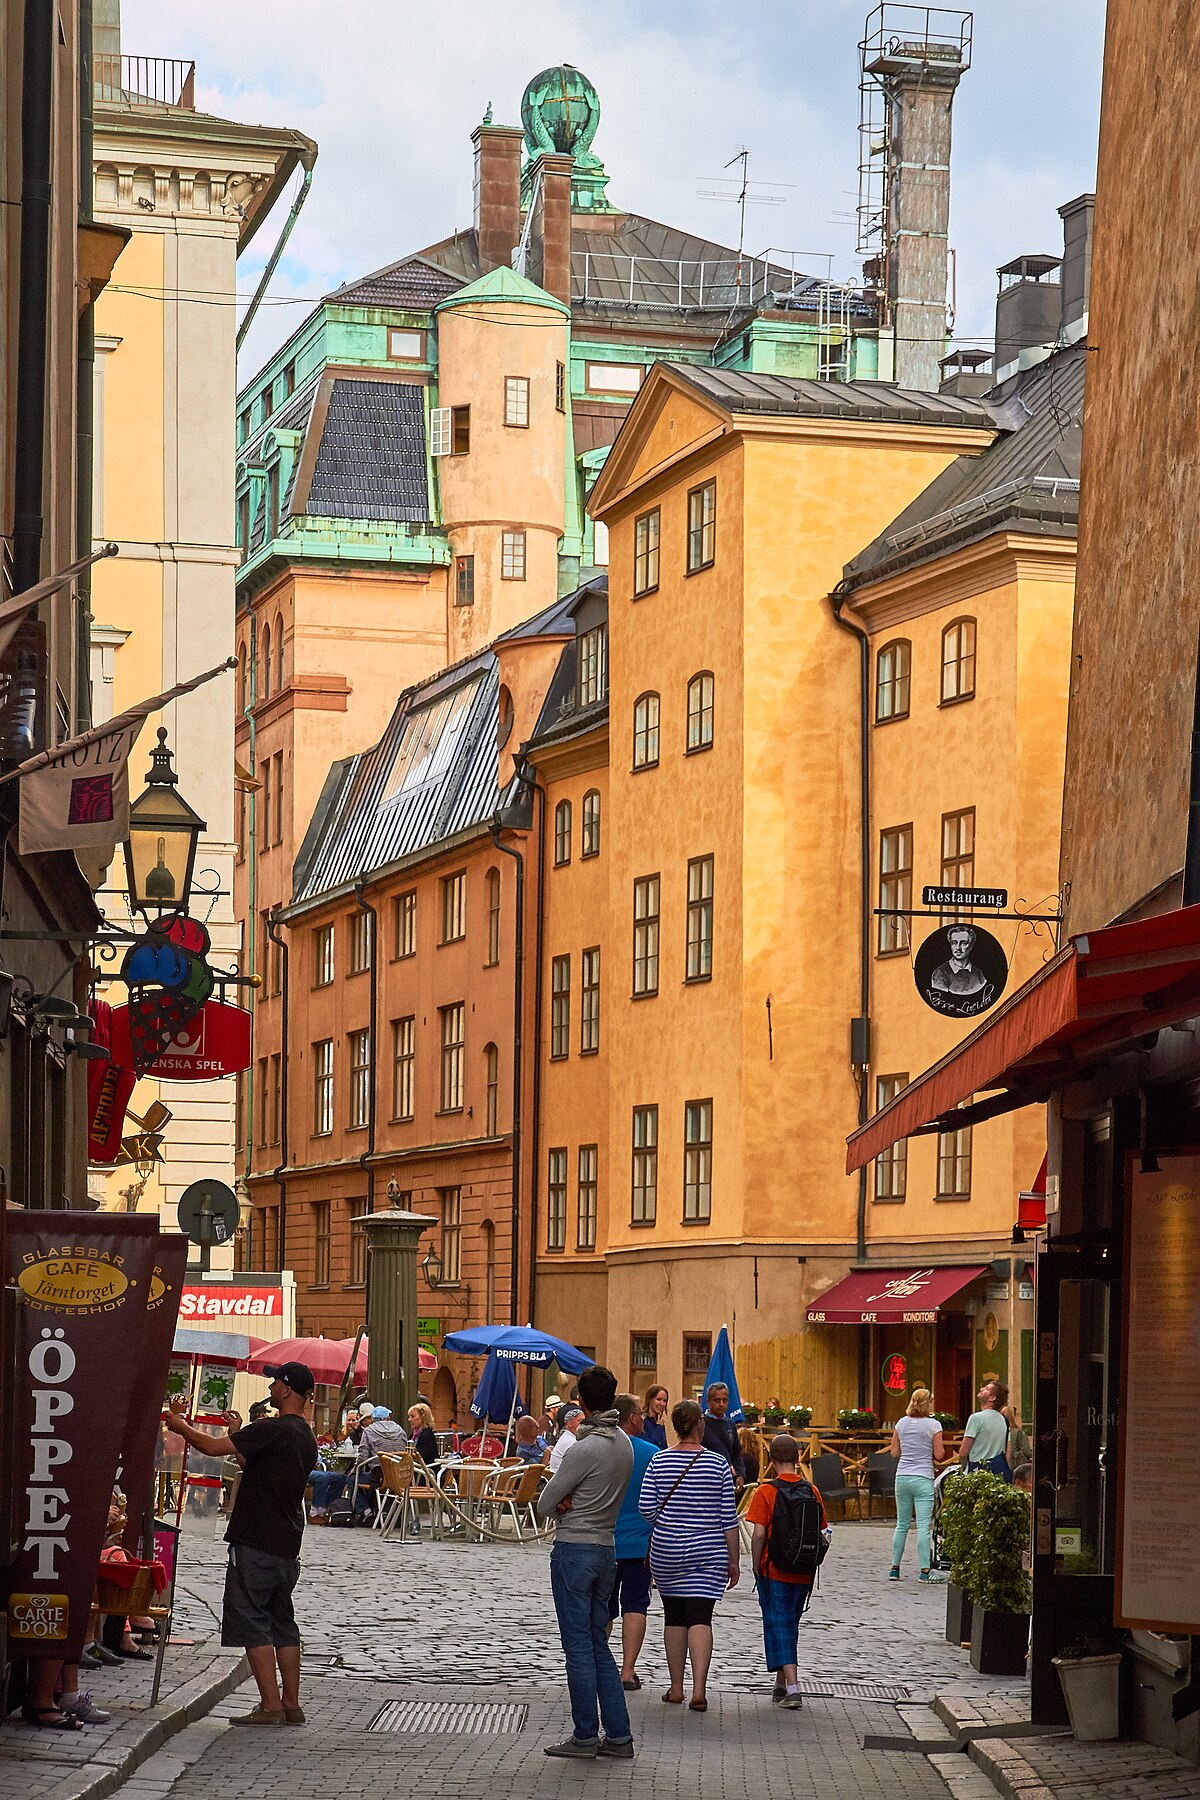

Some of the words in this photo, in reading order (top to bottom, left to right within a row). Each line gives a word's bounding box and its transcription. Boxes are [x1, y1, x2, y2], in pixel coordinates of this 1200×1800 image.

[927, 888, 1003, 907] Restaurang
[195, 1060, 225, 1071] SPEL
[22, 1246, 125, 1268] GLASSBAR
[34, 1279, 116, 1304] Järntorget
[180, 1293, 275, 1316] Stavdal
[807, 1312, 826, 1322] GLASS
[860, 1312, 877, 1322] CAFE
[903, 1312, 935, 1322] KONDITORI
[496, 1349, 529, 1360] PRIPPS
[529, 1350, 547, 1361] BLÅ
[23, 1327, 76, 1580] ÖPPET
[12, 1604, 65, 1624] CARTE
[19, 1619, 60, 1638] D'OR
